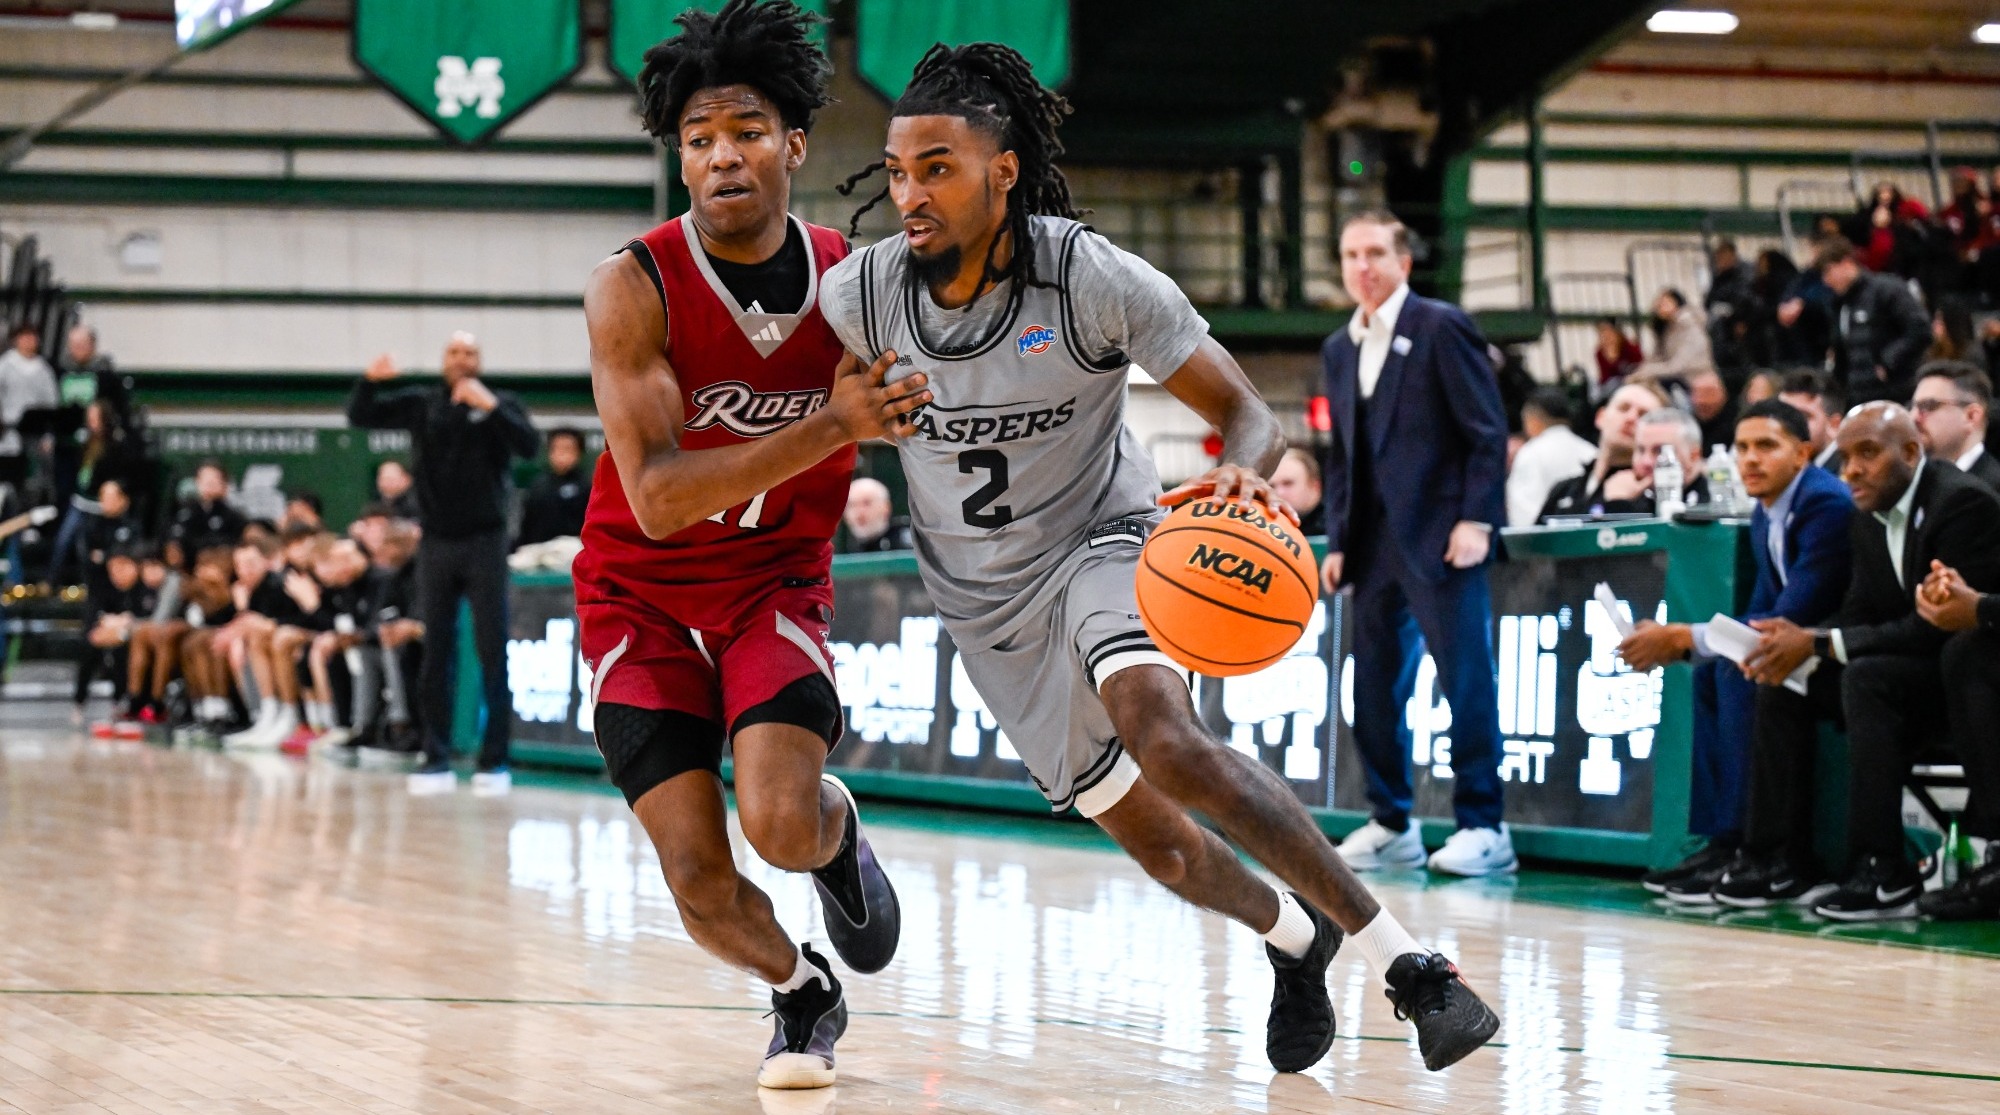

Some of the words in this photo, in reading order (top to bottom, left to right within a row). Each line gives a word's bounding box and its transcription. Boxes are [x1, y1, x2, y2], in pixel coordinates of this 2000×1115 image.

[1018, 329, 1057, 353] MAAC
[684, 380, 828, 438] RIDER
[958, 449, 1013, 529] 2
[1191, 501, 1301, 561] Wilson
[1188, 543, 1273, 594] NCAA
